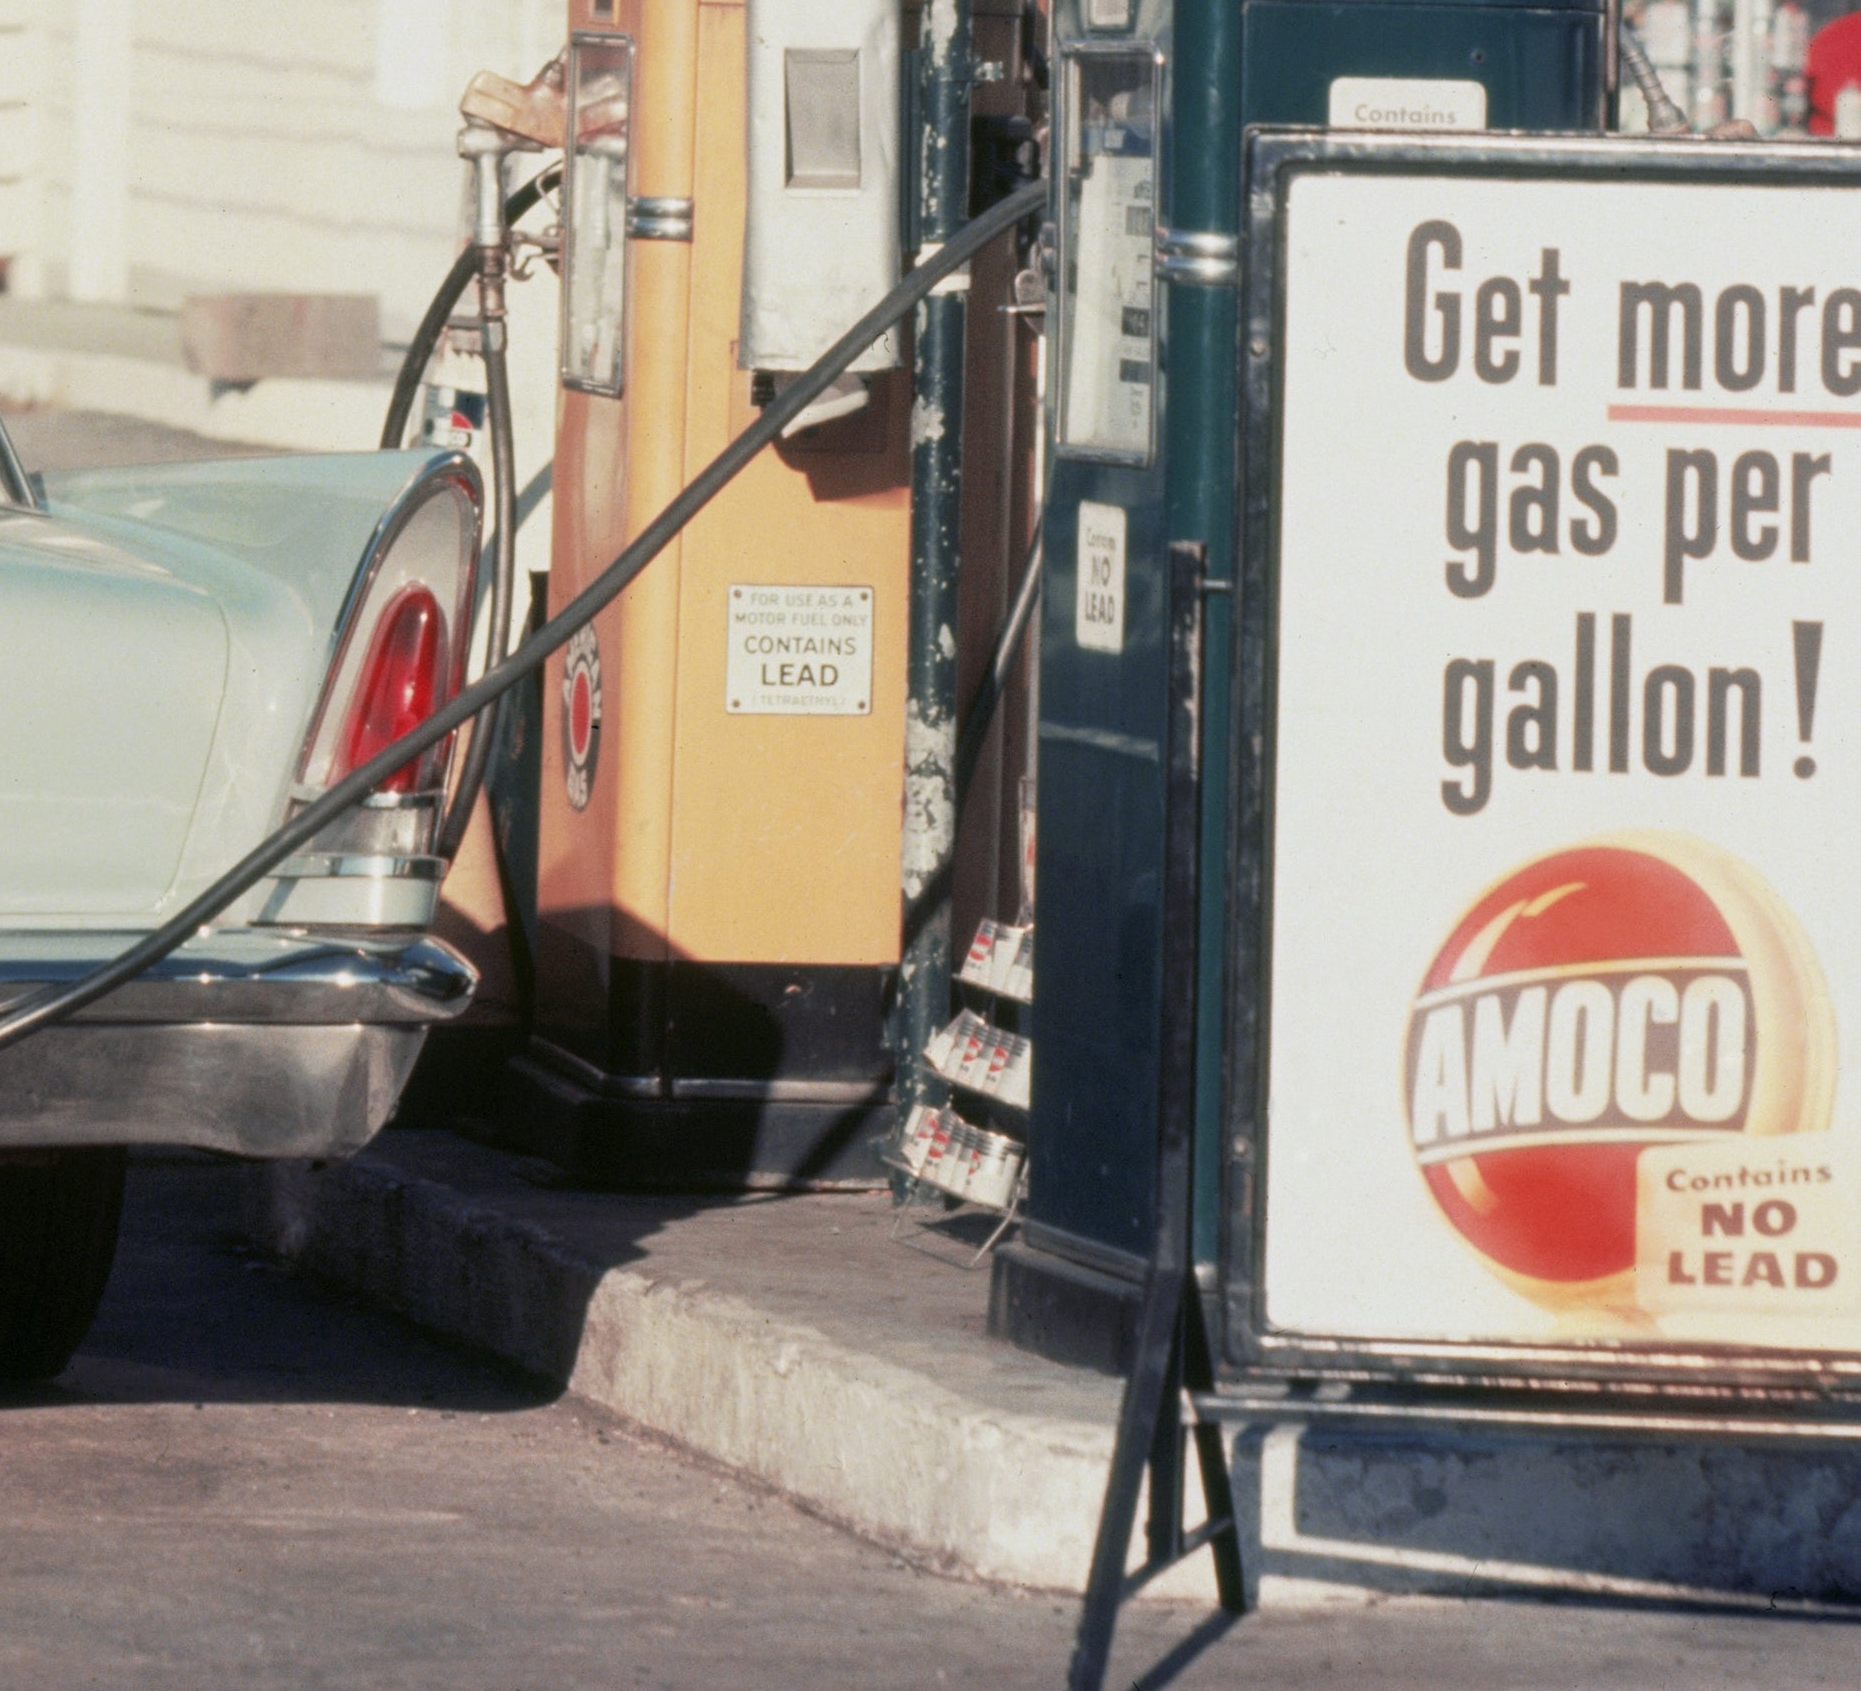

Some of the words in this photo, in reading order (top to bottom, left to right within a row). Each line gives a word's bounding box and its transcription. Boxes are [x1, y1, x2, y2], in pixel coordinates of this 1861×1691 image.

[1354, 103, 1457, 125] Contains
[1403, 219, 1571, 387] Get
[1617, 280, 1861, 397] more
[1444, 439, 1620, 599] gas
[1663, 447, 1832, 605] per
[1091, 554, 1112, 588] NO
[751, 592, 778, 606] FOR
[786, 593, 813, 608] USE
[819, 594, 837, 608] AS
[843, 594, 854, 608] A
[1084, 590, 1115, 626] LEAD
[735, 612, 787, 626] MOTOR
[792, 612, 827, 627] FUEL
[833, 613, 868, 628] ONLY
[744, 635, 857, 656] CONTAINS
[761, 663, 840, 687] LEAD
[1441, 612, 1824, 815] gallon!
[1413, 975, 1746, 1146] AMOCO
[1666, 1159, 1832, 1193] Contains
[1701, 1199, 1798, 1238] NO
[1667, 1251, 1839, 1290] LEAD
